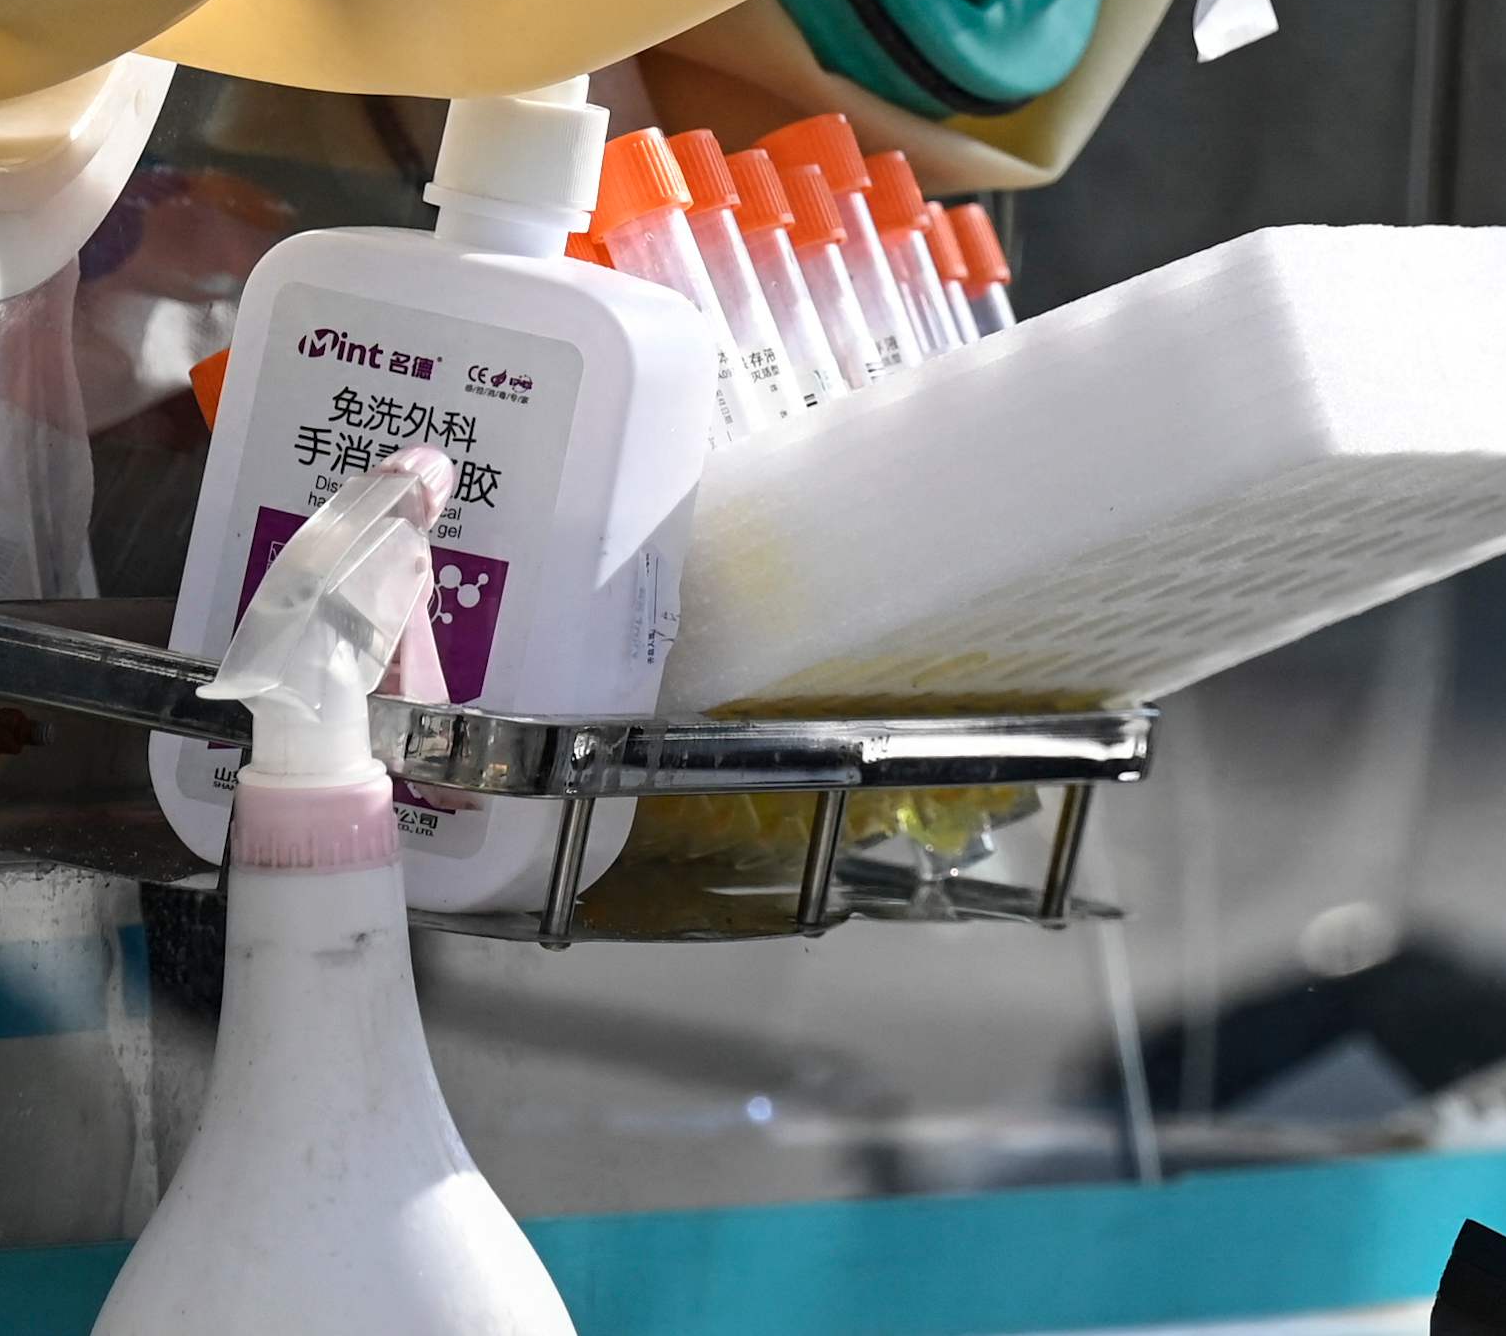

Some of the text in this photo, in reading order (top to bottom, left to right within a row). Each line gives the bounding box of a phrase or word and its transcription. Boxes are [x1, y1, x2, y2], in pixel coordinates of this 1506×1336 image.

[328, 386, 478, 453] 免洗外科
[294, 425, 502, 508] 手消胶
[393, 807, 439, 830] 公司
